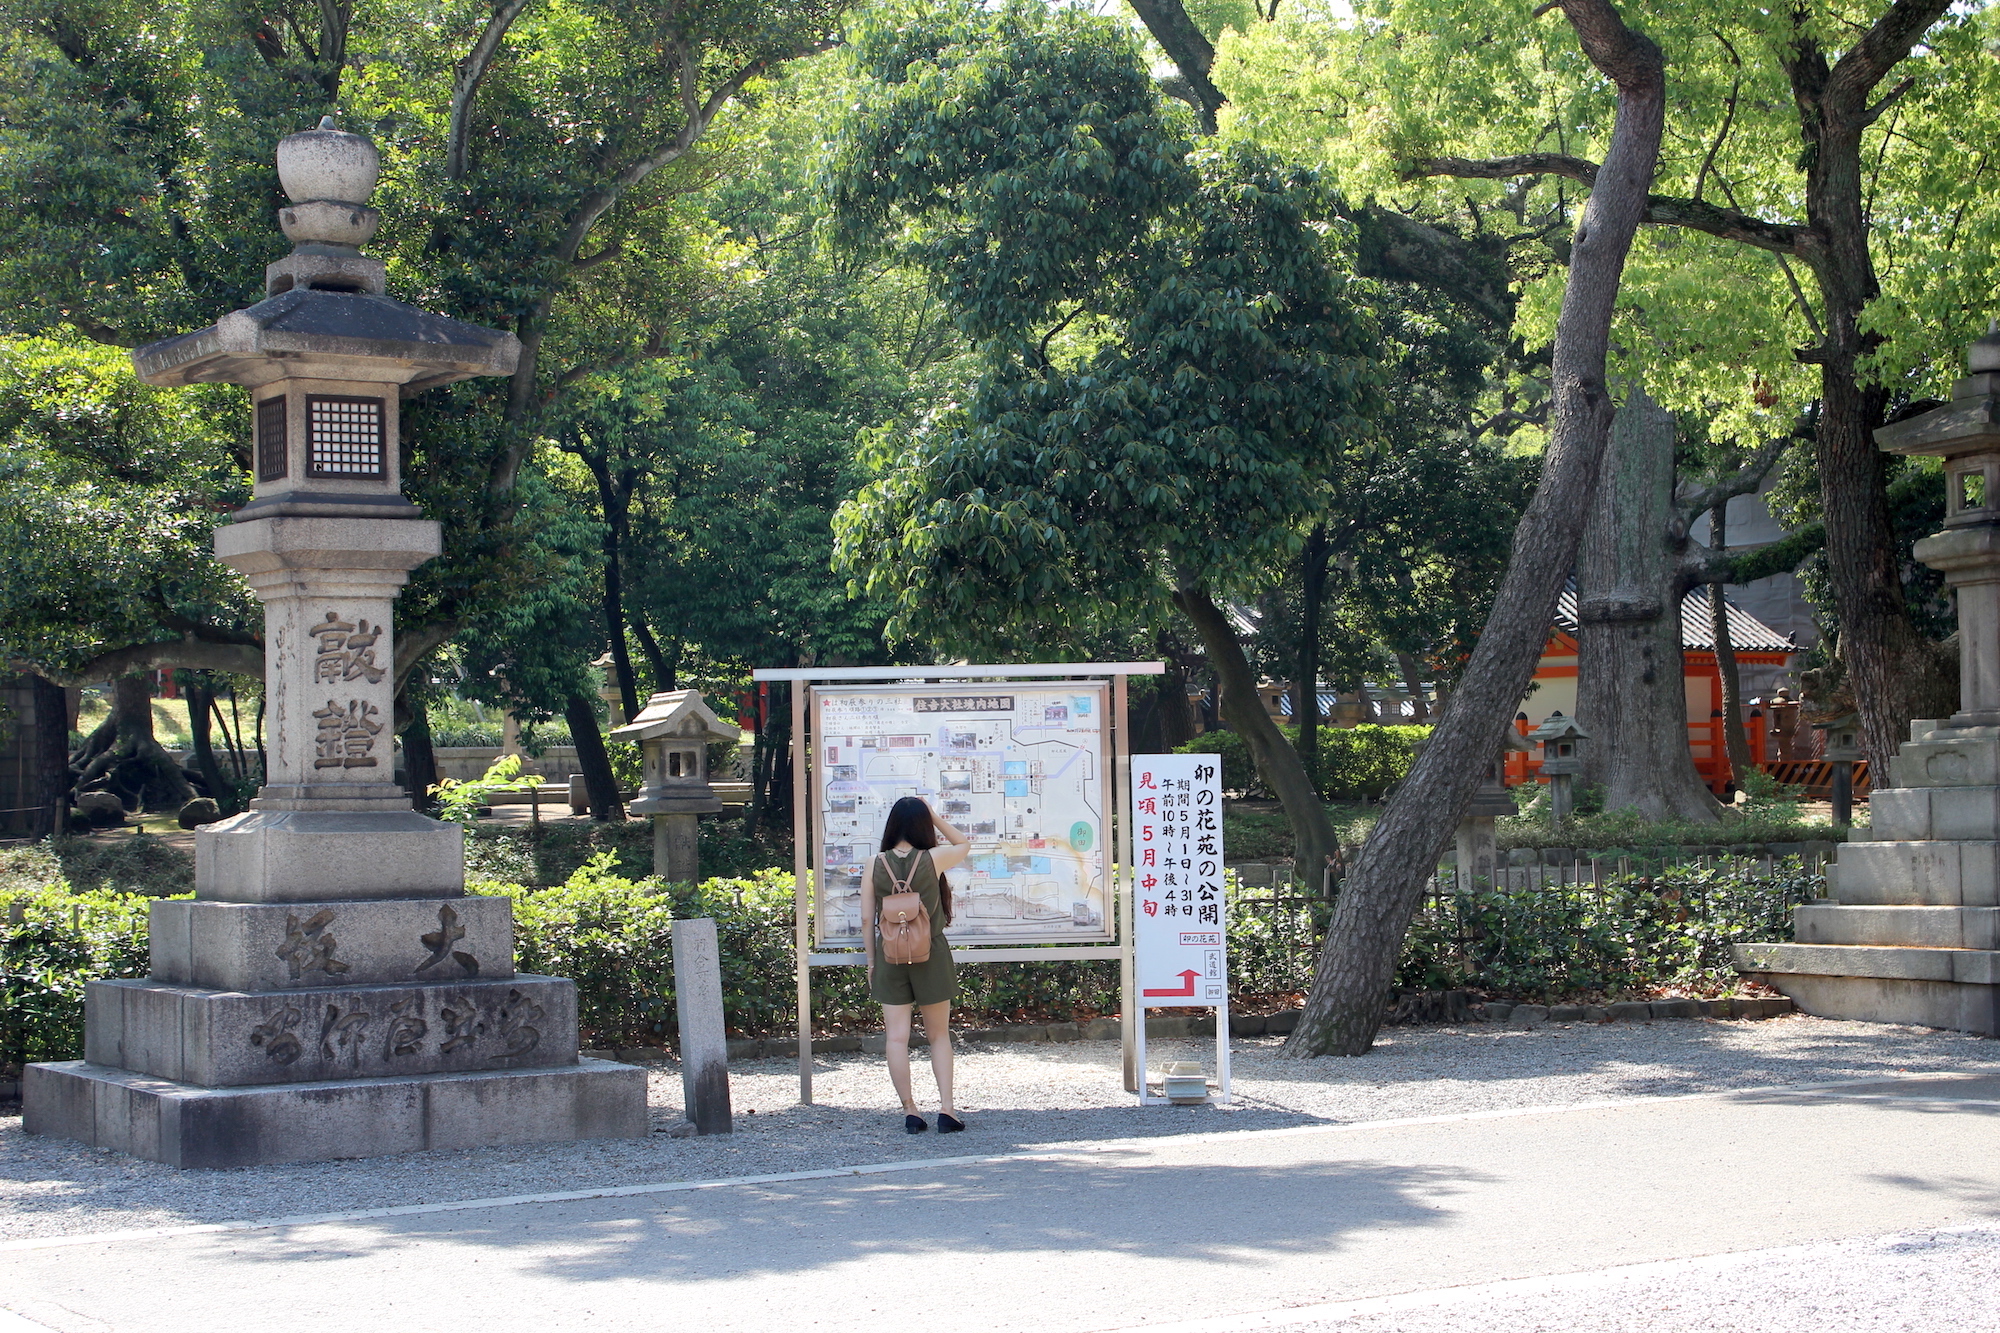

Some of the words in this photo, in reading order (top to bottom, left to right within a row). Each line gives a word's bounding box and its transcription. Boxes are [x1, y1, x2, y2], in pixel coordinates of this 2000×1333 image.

[1138, 771, 1158, 918] 見頃5月中旬
[1194, 764, 1219, 926] 卯の花苑の公開
[1183, 935, 1217, 944] 卯の花苑
